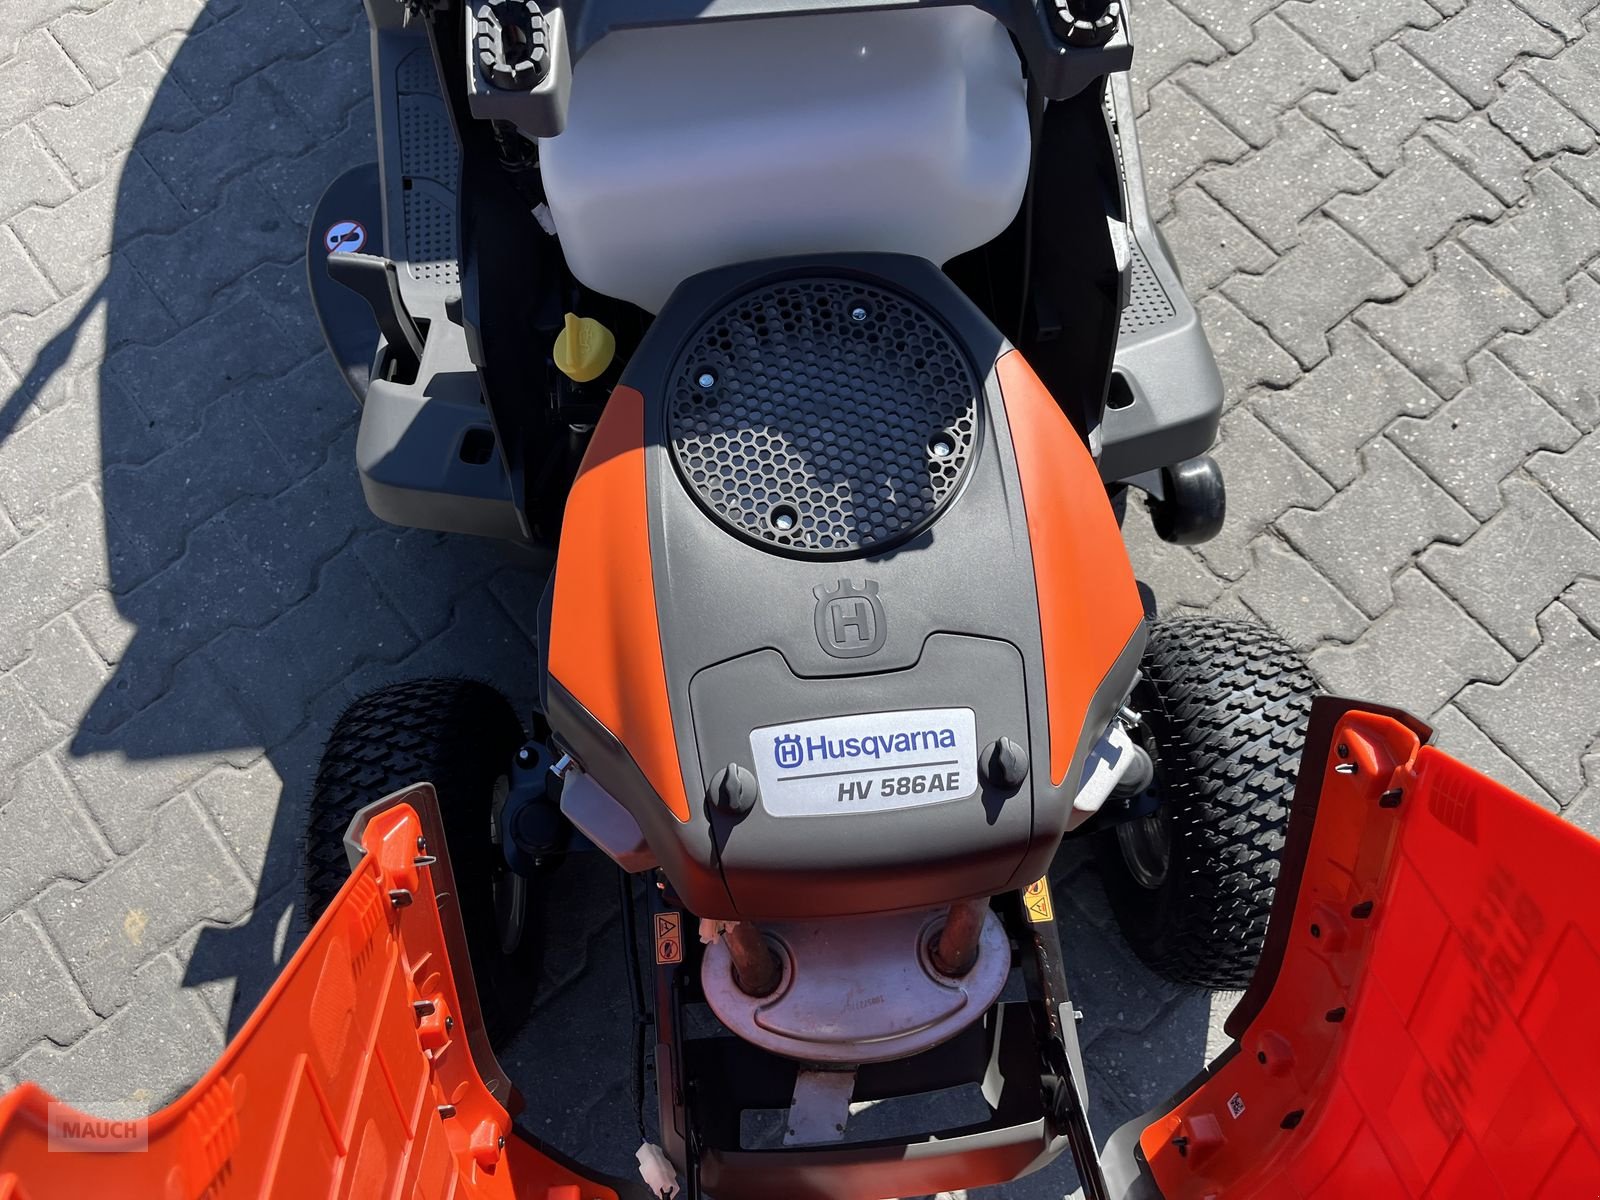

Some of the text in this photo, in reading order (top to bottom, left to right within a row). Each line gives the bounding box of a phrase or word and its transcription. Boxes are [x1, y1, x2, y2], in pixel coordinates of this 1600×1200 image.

[831, 602, 869, 643] H
[806, 728, 956, 760] Husqvarna
[838, 772, 960, 801] HV 586AE
